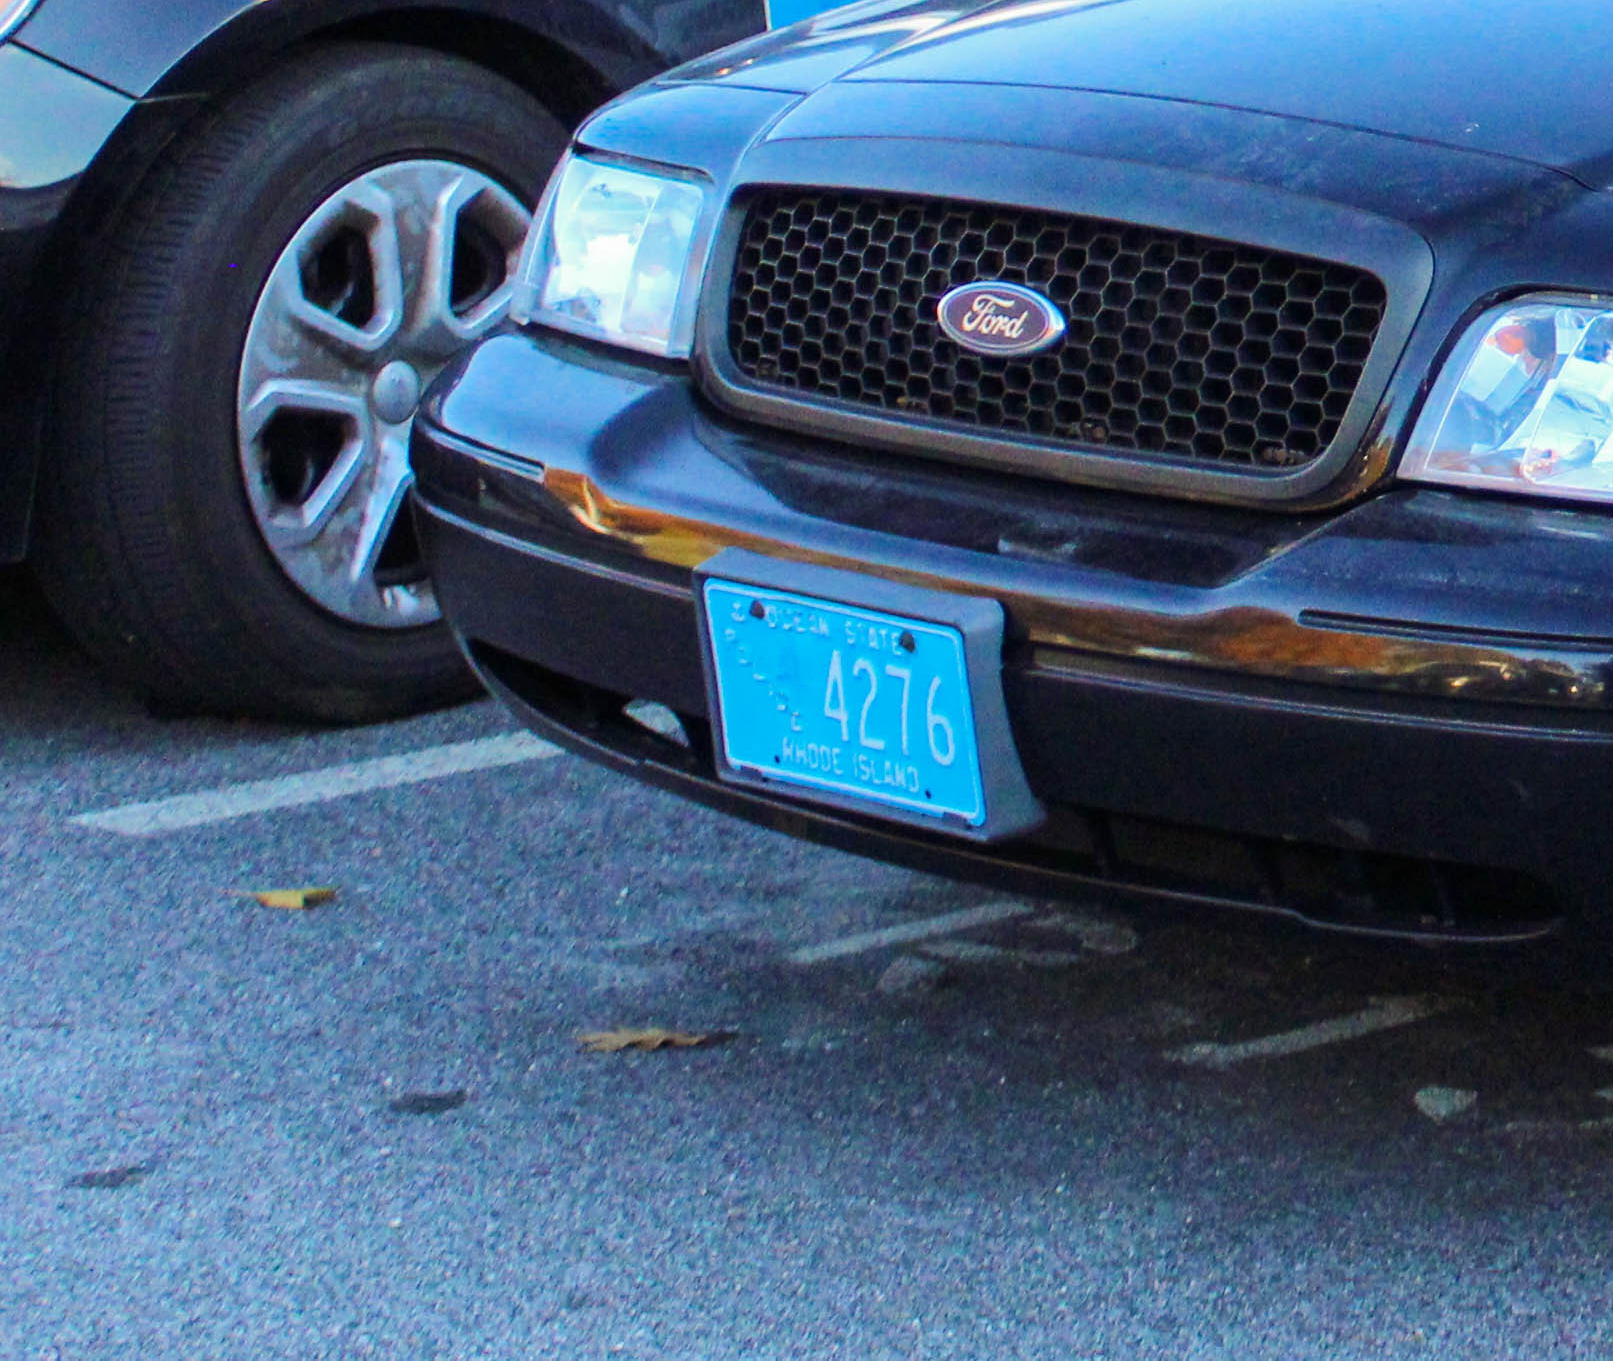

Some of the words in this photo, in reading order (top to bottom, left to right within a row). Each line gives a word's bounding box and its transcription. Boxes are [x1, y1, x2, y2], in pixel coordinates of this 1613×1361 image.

[962, 293, 1029, 339] Ford
[844, 620, 903, 656] STATE
[823, 649, 956, 767] 4276
[781, 735, 844, 776] RHODE
[852, 751, 921, 794] ISLAND
